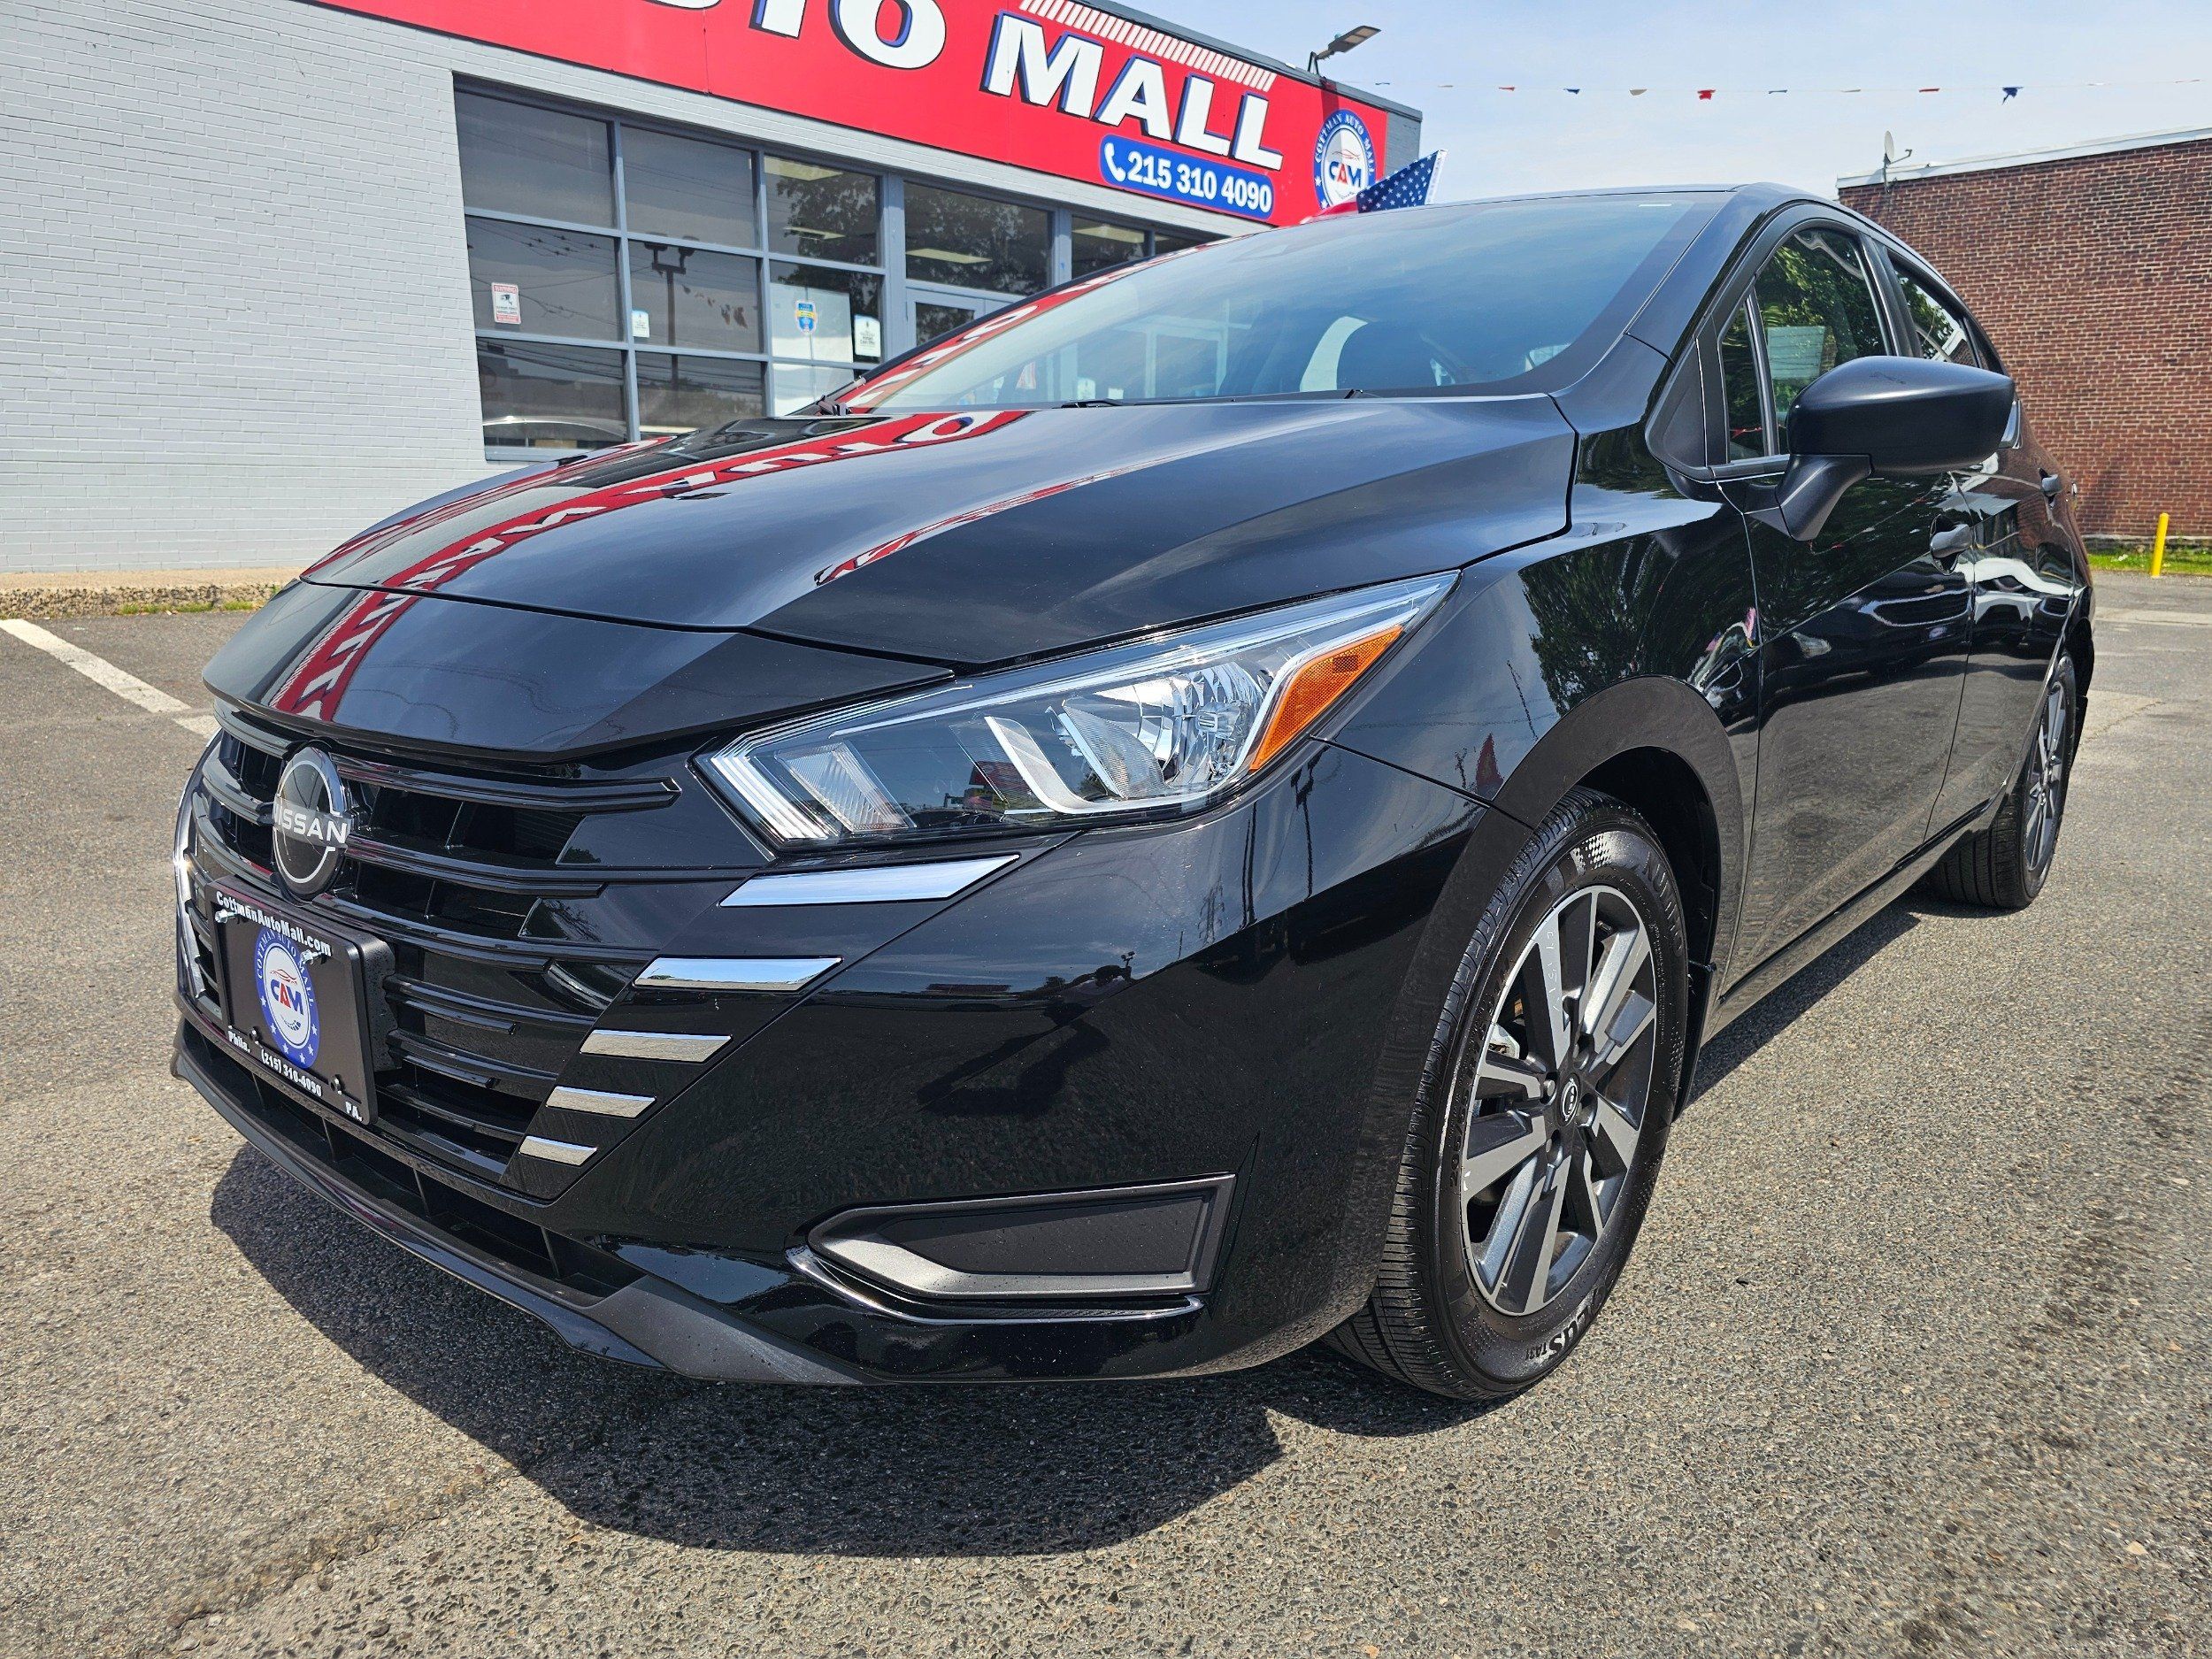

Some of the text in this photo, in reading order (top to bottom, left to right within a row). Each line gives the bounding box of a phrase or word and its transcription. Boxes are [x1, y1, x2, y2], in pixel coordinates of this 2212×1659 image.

[979, 10, 1284, 171] MALL
[1345, 114, 1364, 135] AUTO
[1127, 151, 1272, 212] 215 310 4090
[1329, 161, 1362, 187] CAM
[273, 802, 348, 843] NISSAN
[216, 890, 332, 957] CottmanAutoMall.com
[257, 929, 275, 979] COTTMAN
[278, 933, 296, 956] AUTO
[271, 979, 303, 1015] CAM
[227, 1031, 363, 1122] Phila. (215) 310-4090 PA.
